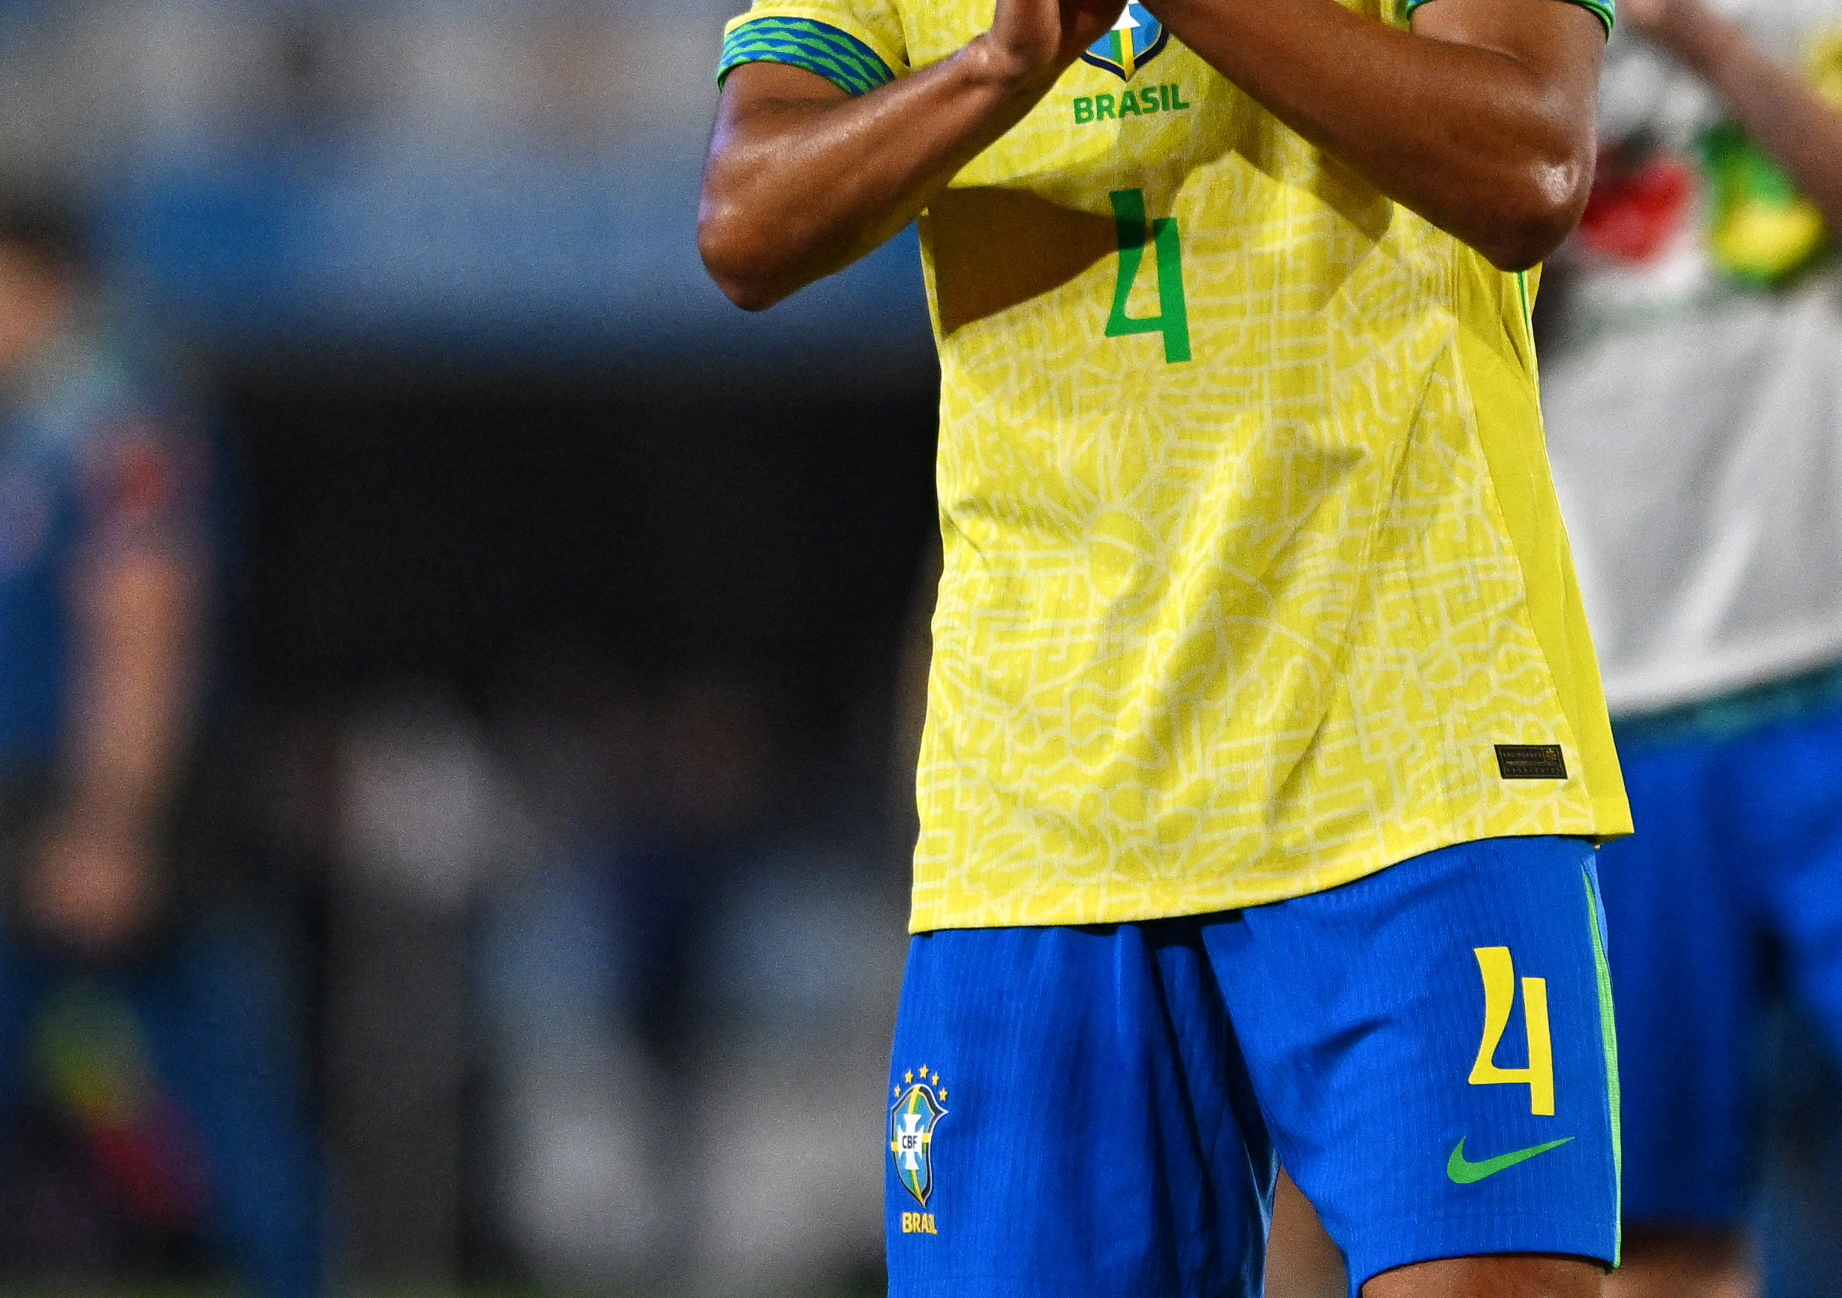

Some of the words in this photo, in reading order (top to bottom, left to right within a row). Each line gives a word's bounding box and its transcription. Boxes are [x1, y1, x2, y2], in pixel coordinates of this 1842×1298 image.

[1073, 83, 1190, 124] BRASIL
[1104, 188, 1192, 364] 4
[1468, 946, 1555, 1116] 4
[902, 1135, 918, 1149] CBF
[902, 1212, 938, 1234] BRAL
